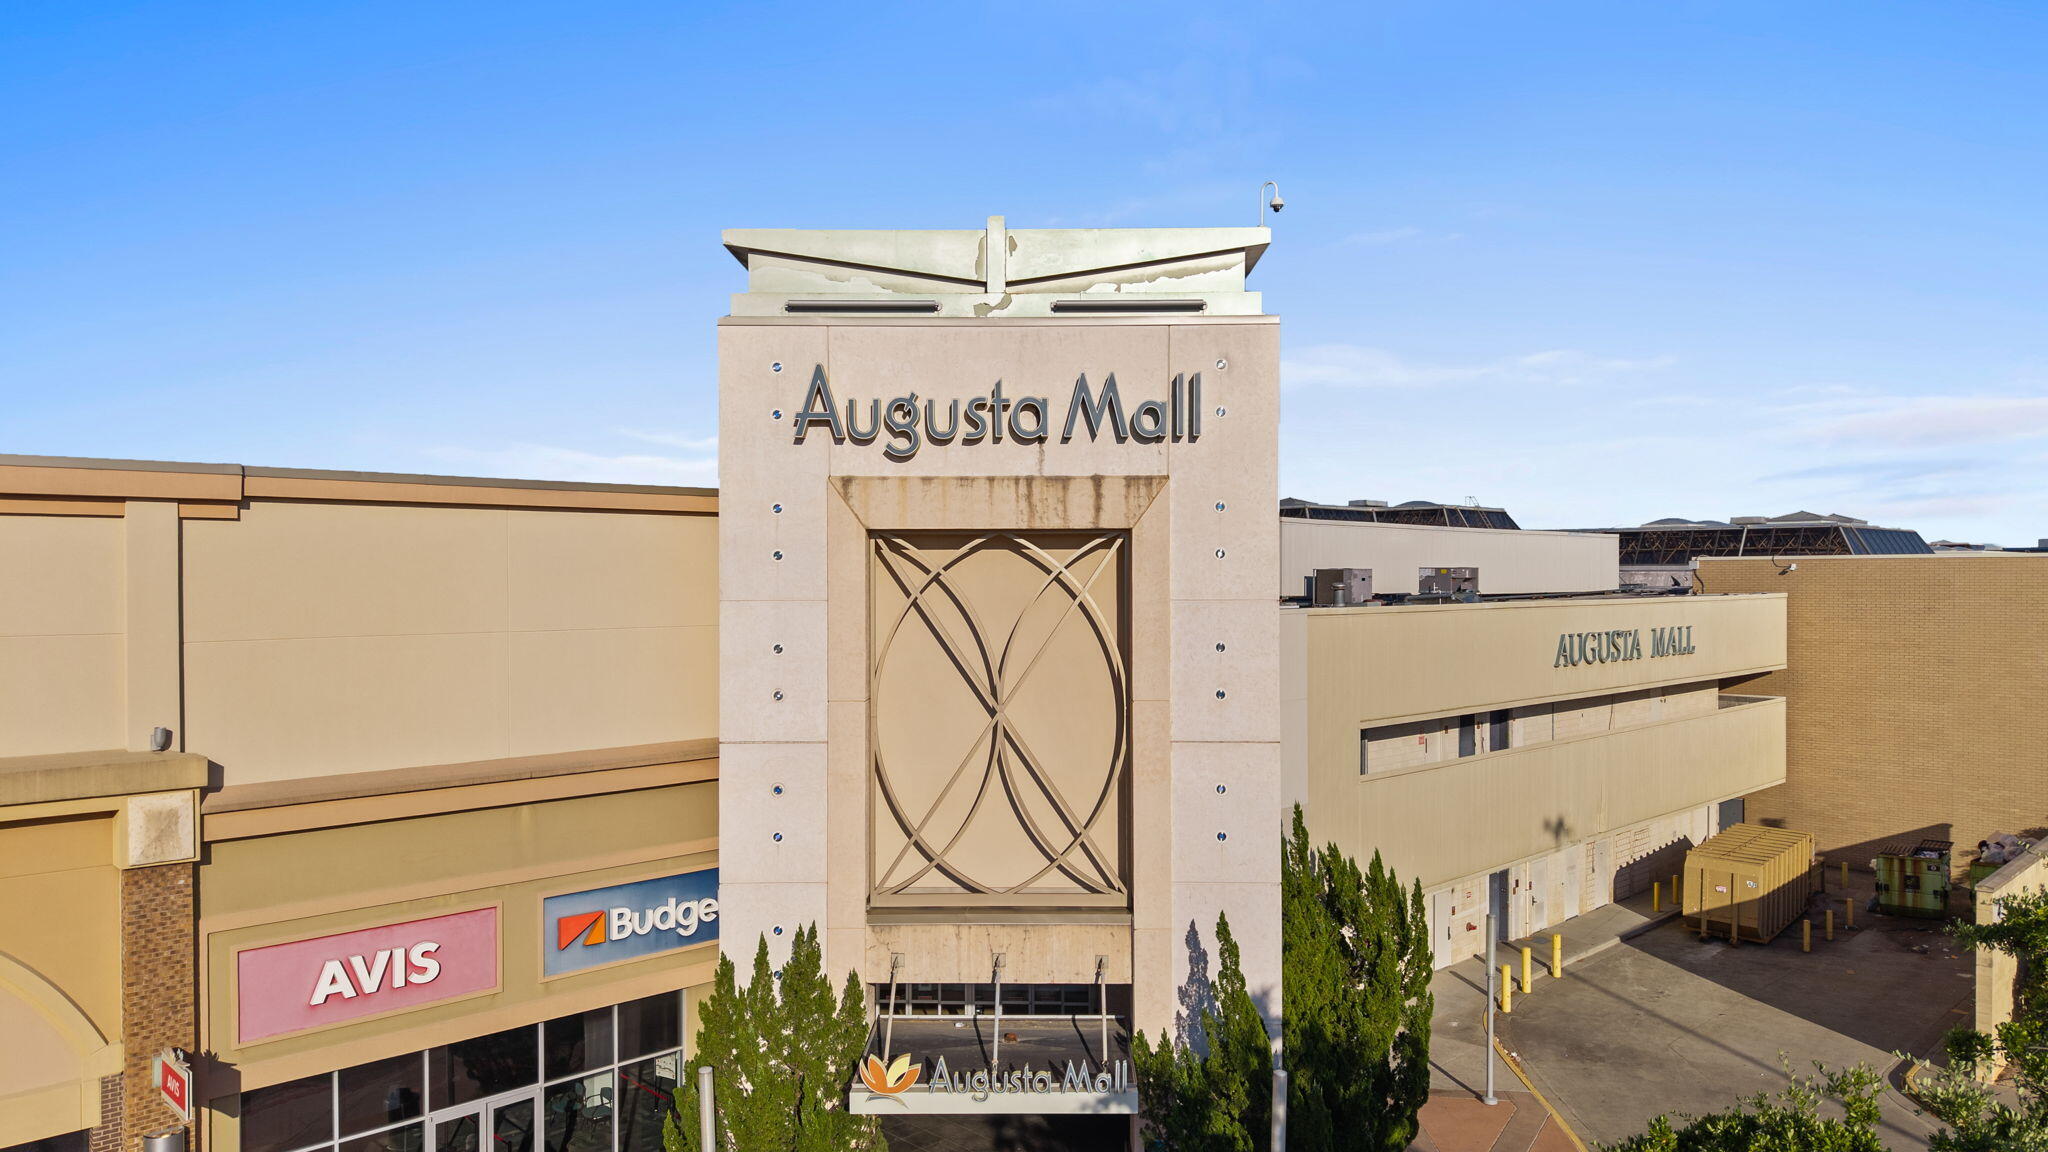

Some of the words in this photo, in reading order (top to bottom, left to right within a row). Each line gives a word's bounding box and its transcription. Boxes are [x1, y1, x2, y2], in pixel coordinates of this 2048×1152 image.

[793, 362, 1049, 459] Augusta
[1062, 372, 1201, 441] Mall
[1553, 628, 1642, 668] AUGUSTA
[1650, 625, 1696, 659] MALL
[609, 897, 719, 941] Budge
[309, 941, 441, 1006] AVIS
[166, 1073, 180, 1097] AVIS
[929, 1055, 1052, 1103] Augusta
[1061, 1058, 1128, 1095] Mall
